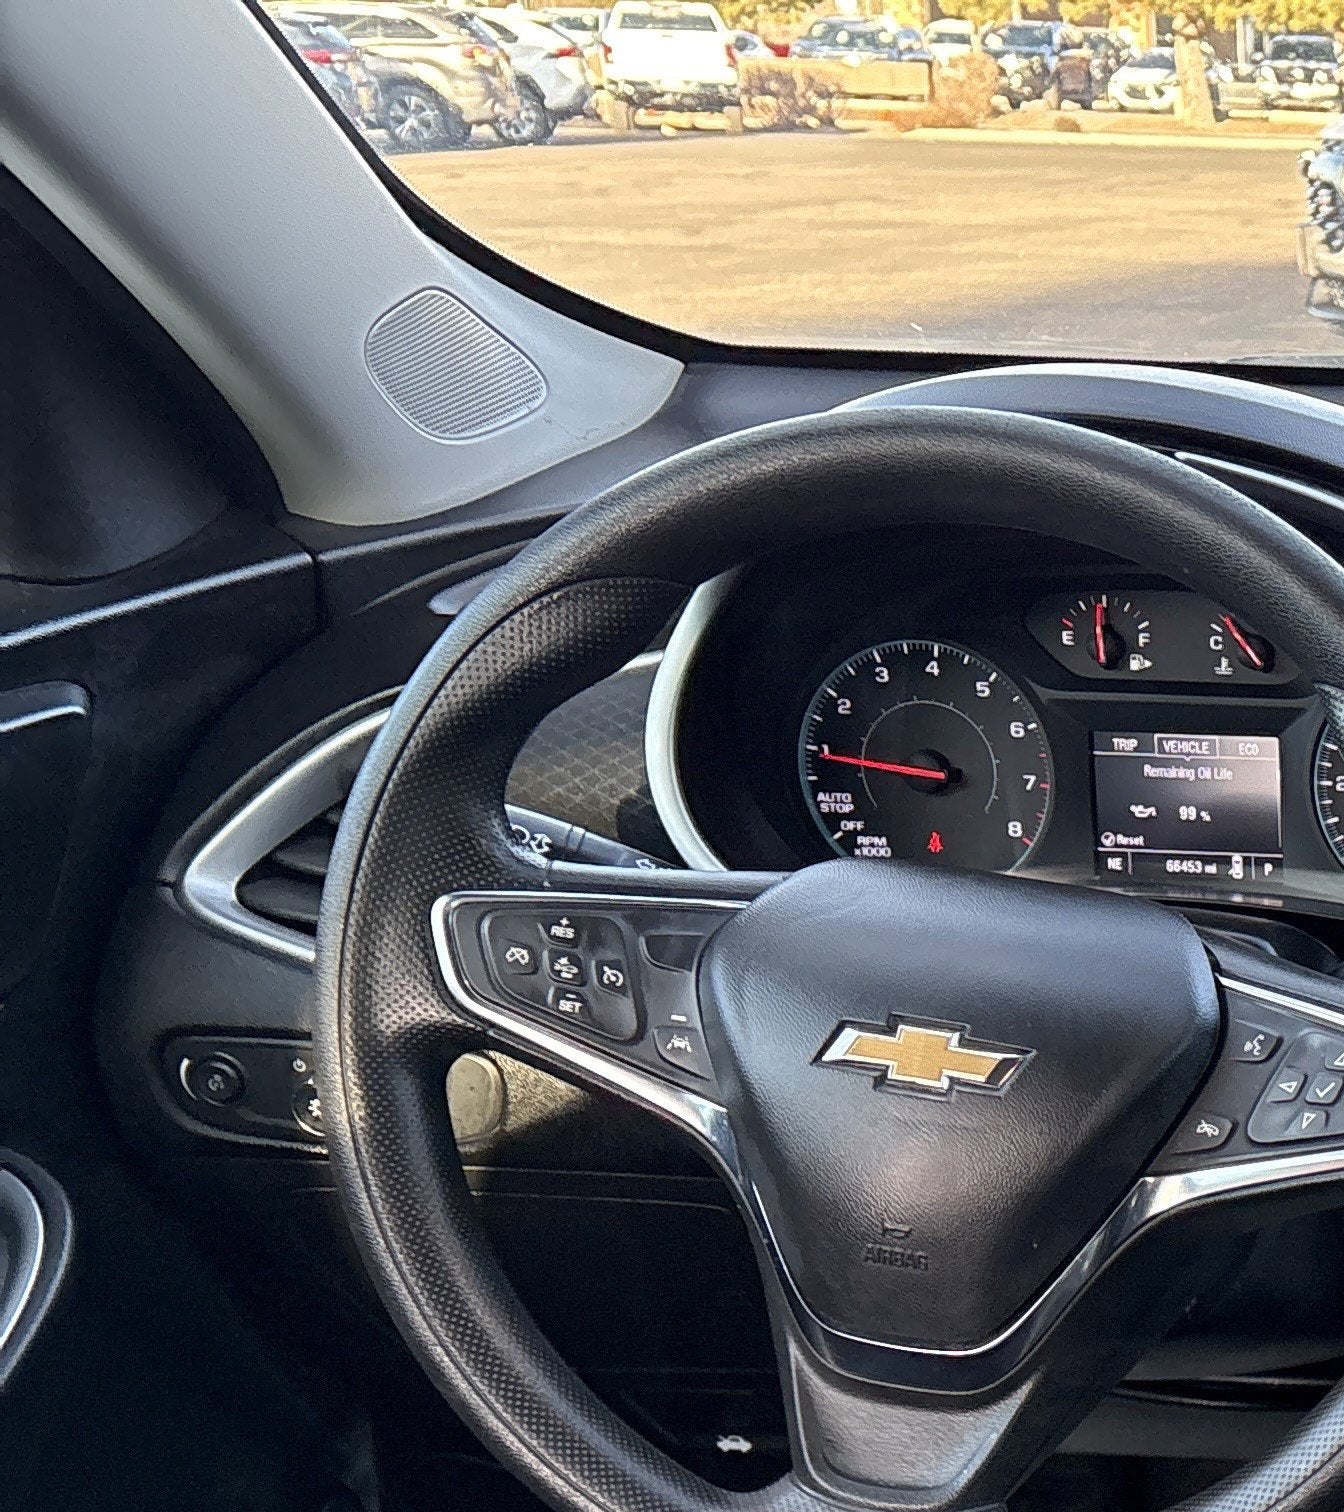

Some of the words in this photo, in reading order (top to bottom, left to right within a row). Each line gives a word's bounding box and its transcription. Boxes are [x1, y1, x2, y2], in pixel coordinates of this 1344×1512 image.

[1061, 630, 1076, 646] E
[1138, 632, 1150, 648] F
[1209, 635, 1223, 650] C
[875, 666, 890, 683] 3
[925, 661, 940, 677] 4
[975, 681, 990, 698] 5
[837, 698, 852, 715] 2
[1009, 721, 1025, 738] 6
[1111, 737, 1139, 752] TRIP
[1162, 739, 1211, 755] VEHICLE
[1238, 742, 1260, 757] ECO
[1143, 764, 1196, 781] Remaining
[1197, 766, 1212, 780] Oil
[1213, 767, 1234, 781] Life
[1022, 774, 1037, 791] 7
[816, 791, 852, 804] AUTO
[819, 803, 855, 815] STOP
[1178, 805, 1197, 821] 99
[840, 820, 865, 832] OFF
[1007, 821, 1023, 838] 8
[856, 835, 887, 847] RPM
[1116, 833, 1145, 847] Reset
[1107, 857, 1123, 871] NE
[1263, 862, 1274, 877] P
[550, 925, 575, 940] RES
[558, 999, 583, 1014] SET
[862, 1243, 930, 1272] AIRBAG
